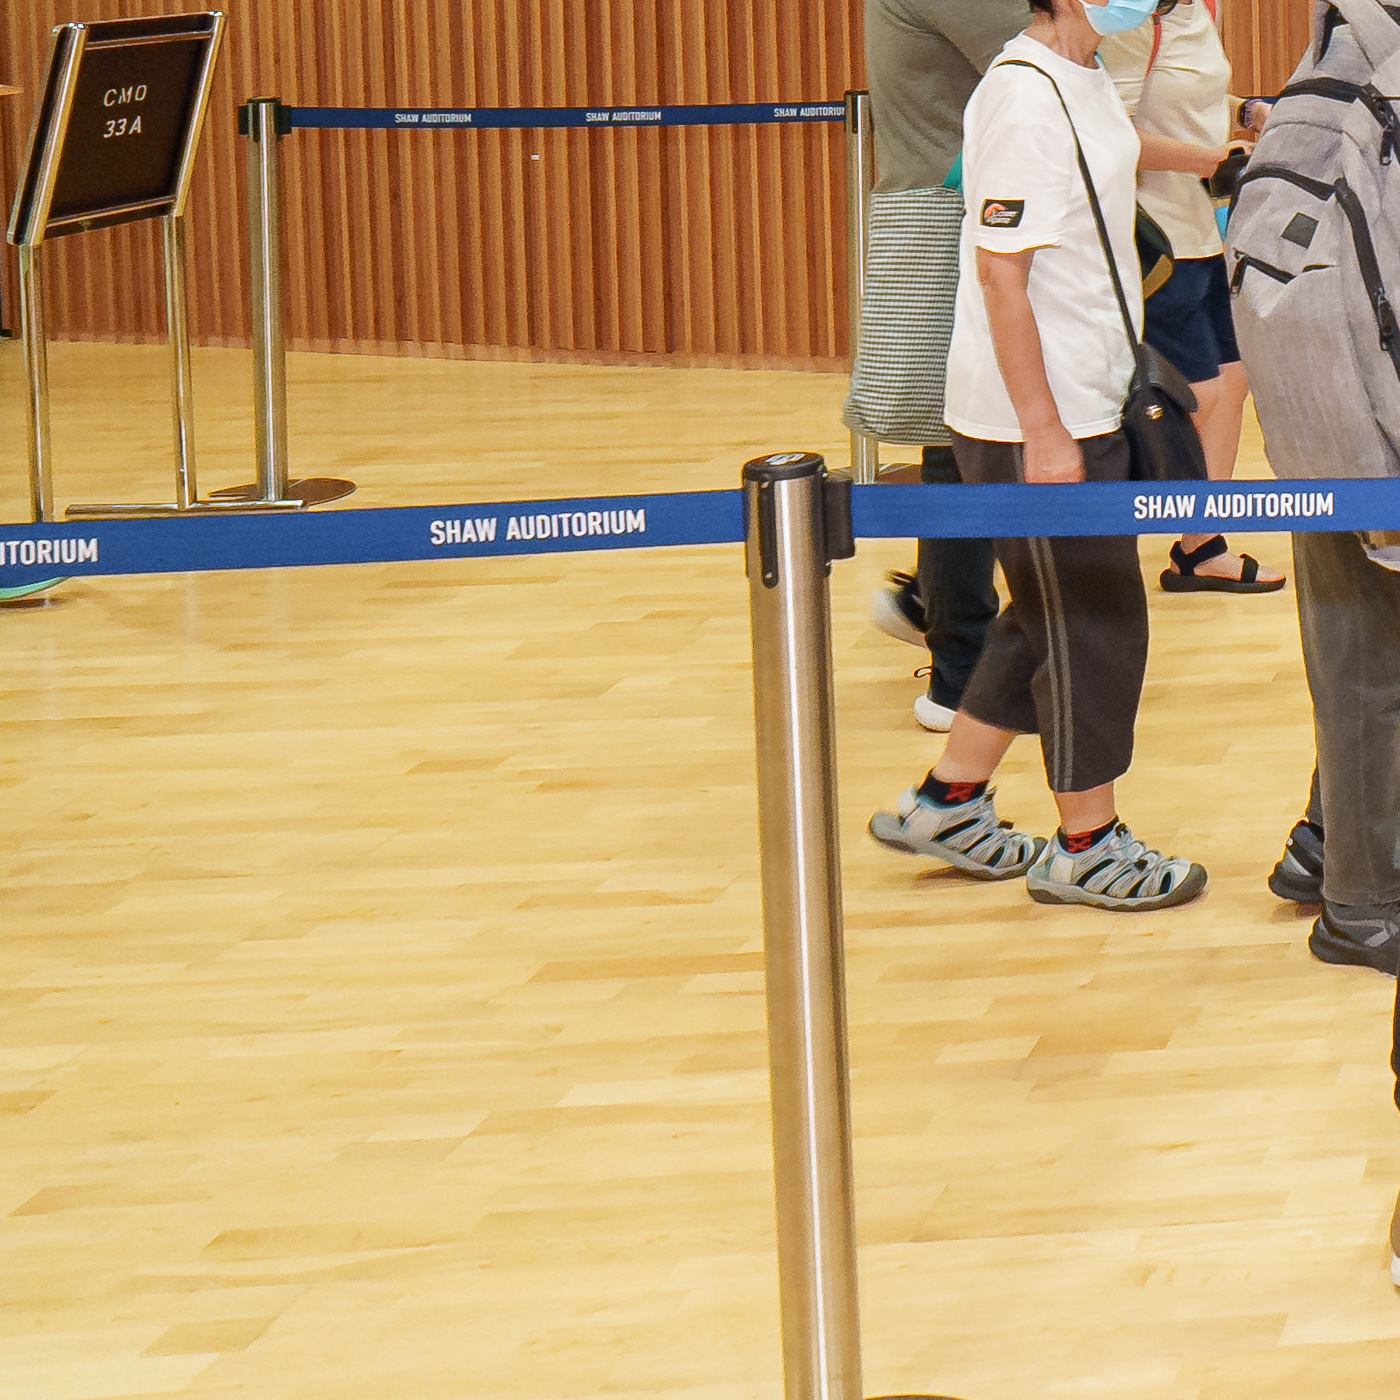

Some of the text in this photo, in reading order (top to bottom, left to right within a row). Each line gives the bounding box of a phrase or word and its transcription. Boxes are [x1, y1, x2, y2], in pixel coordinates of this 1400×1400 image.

[102, 84, 148, 108] CMO
[395, 113, 472, 123] SHAW AUDITORIUM
[586, 111, 662, 122] SHAW AUDITORIUM
[774, 108, 798, 118] SHAW
[103, 115, 143, 139] 33A
[1134, 492, 1334, 519] SHAW AUDITORIUM
[430, 508, 646, 545] SHAW AUDITORIUM
[0, 538, 98, 566] ITORIUM
